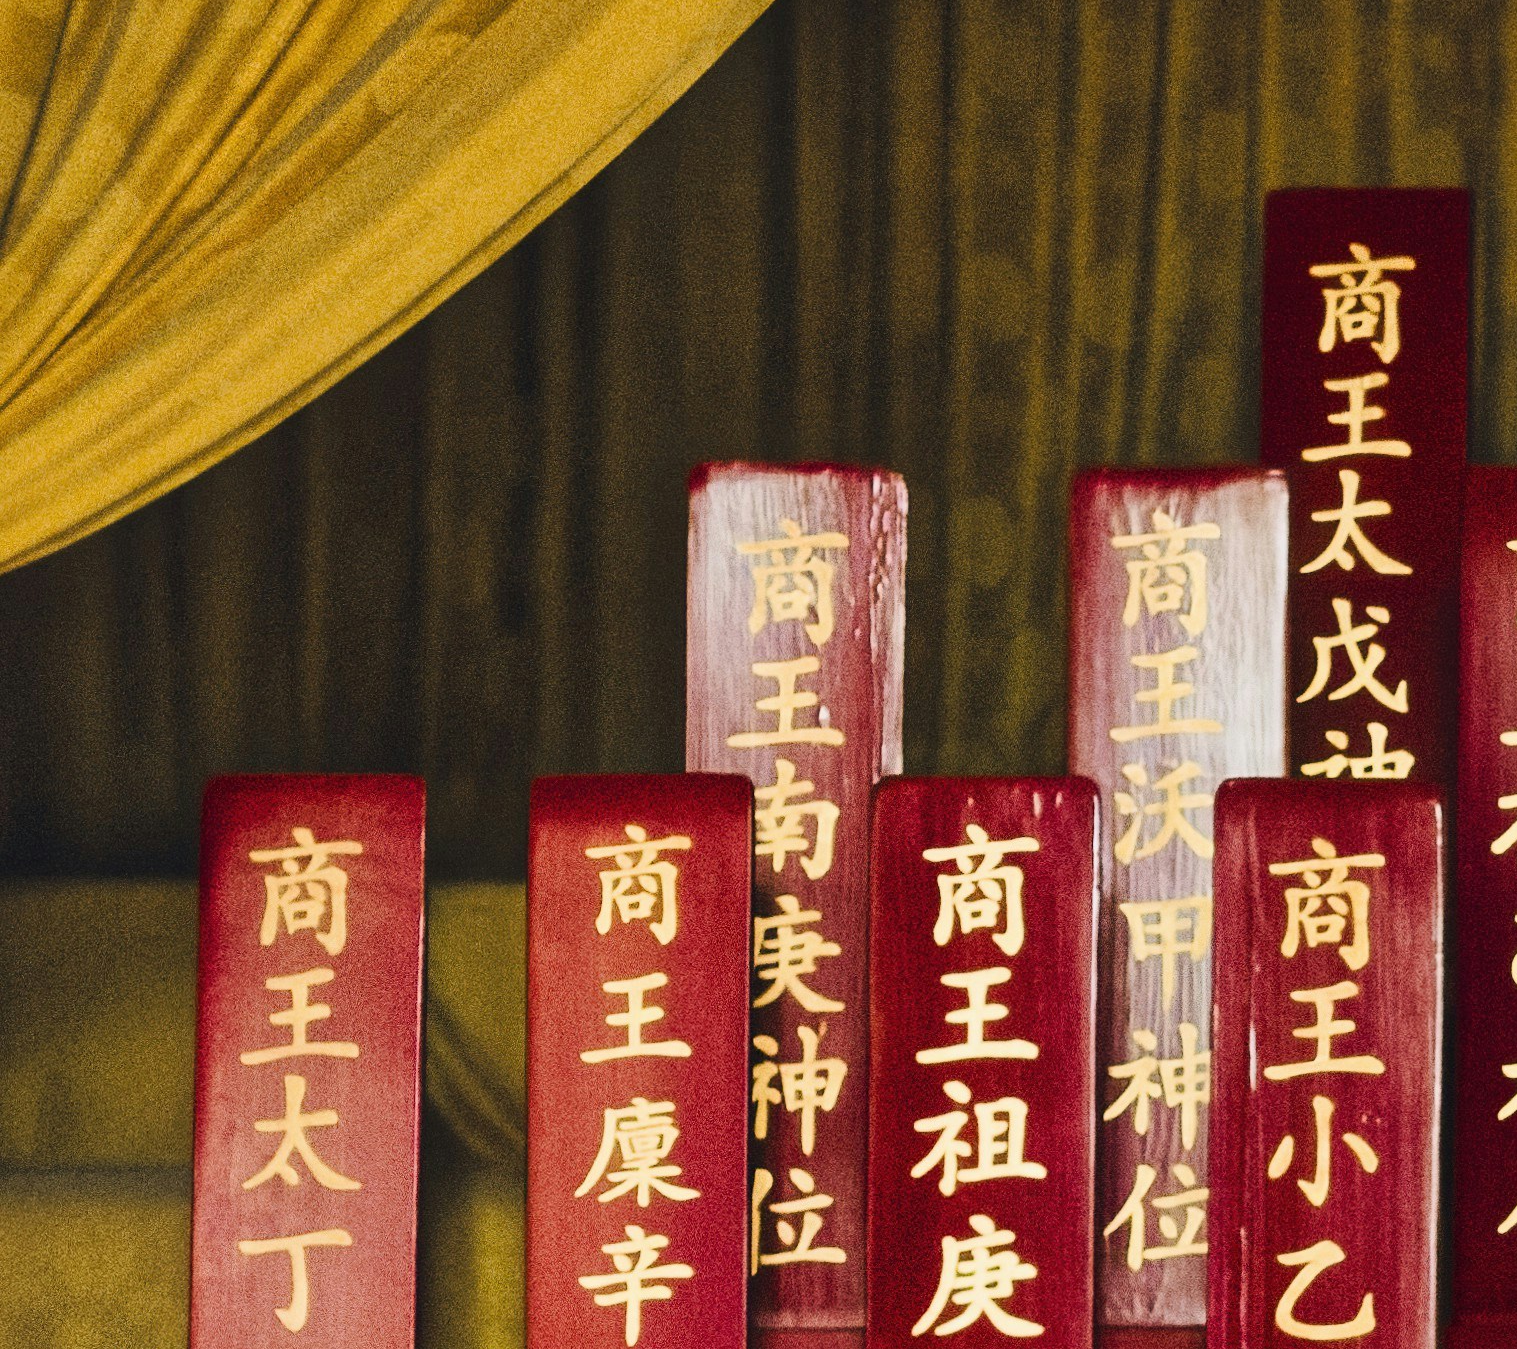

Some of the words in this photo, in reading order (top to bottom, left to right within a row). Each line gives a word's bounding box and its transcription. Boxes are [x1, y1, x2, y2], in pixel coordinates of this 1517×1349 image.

[726, 517, 850, 1276] 商王南庚神位
[1103, 508, 1224, 1271] 商王沃甲神位
